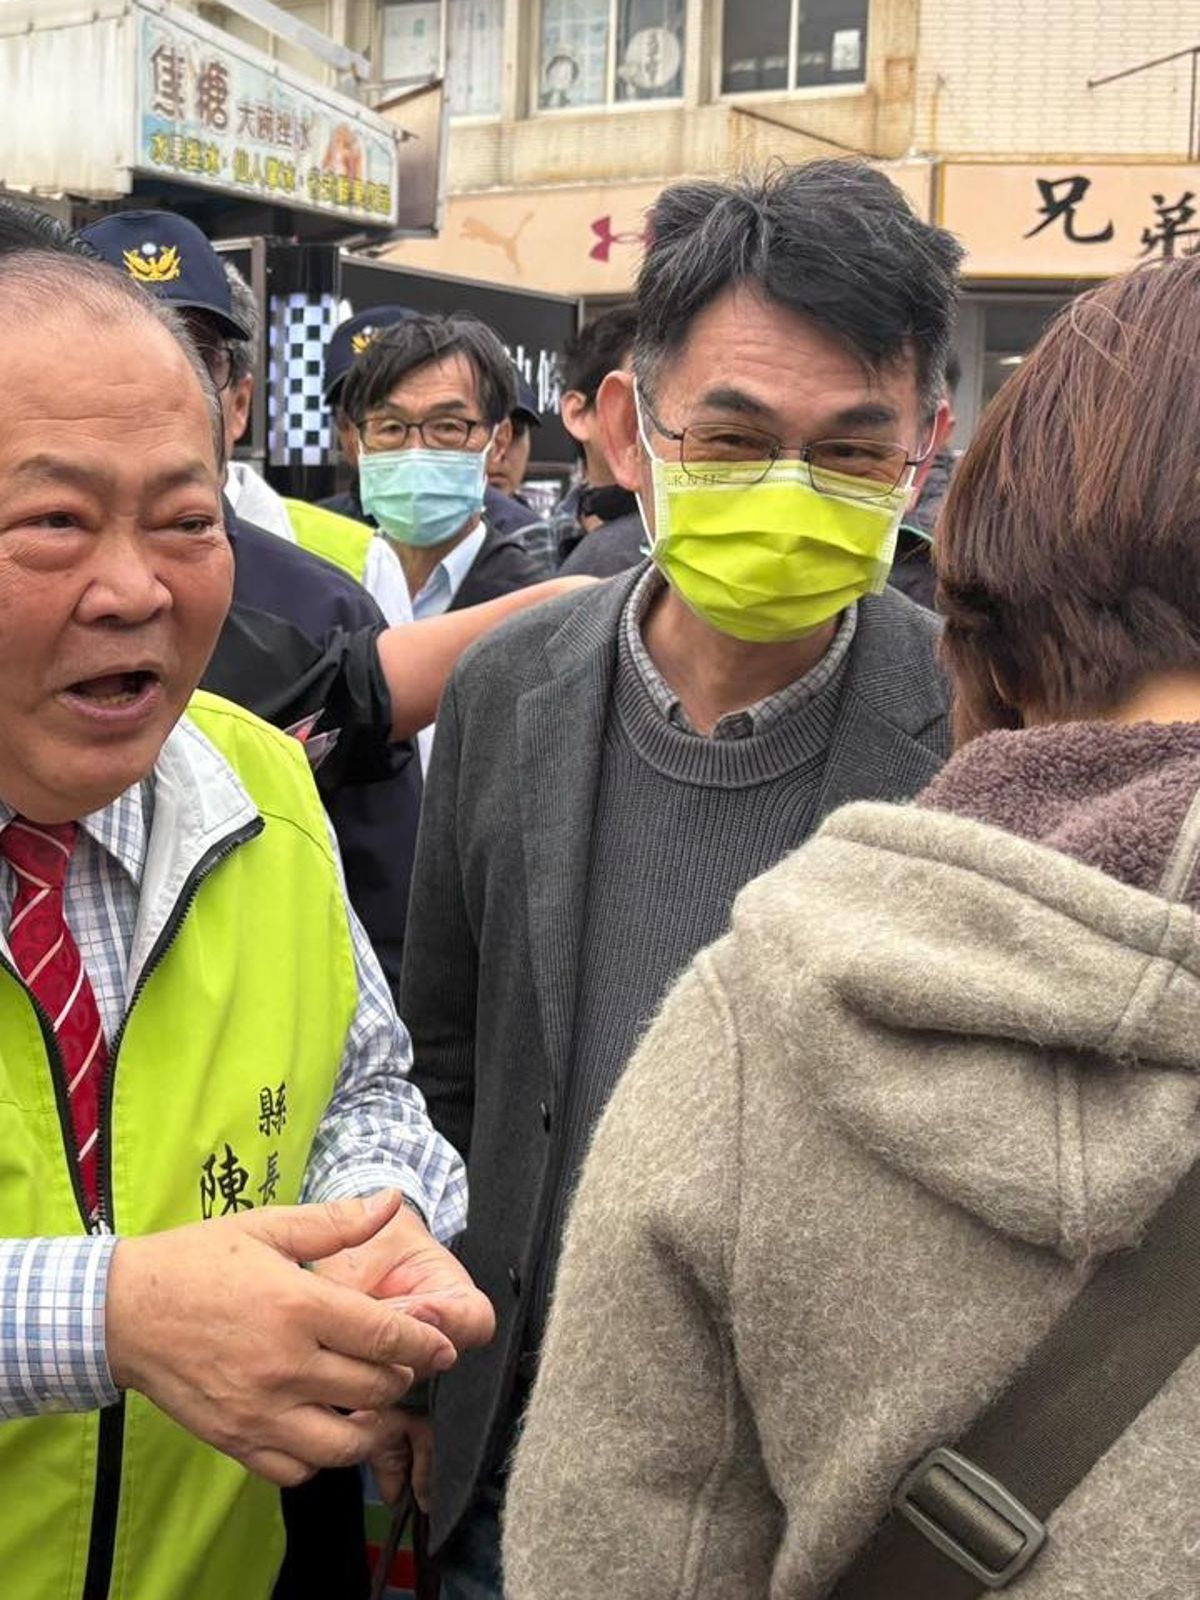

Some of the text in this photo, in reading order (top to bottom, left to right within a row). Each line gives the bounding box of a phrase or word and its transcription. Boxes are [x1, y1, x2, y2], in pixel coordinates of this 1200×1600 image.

[1022, 174, 1200, 257] 兄弟
[200, 1142, 254, 1220] 陳
[258, 1081, 287, 1206] 縣長
